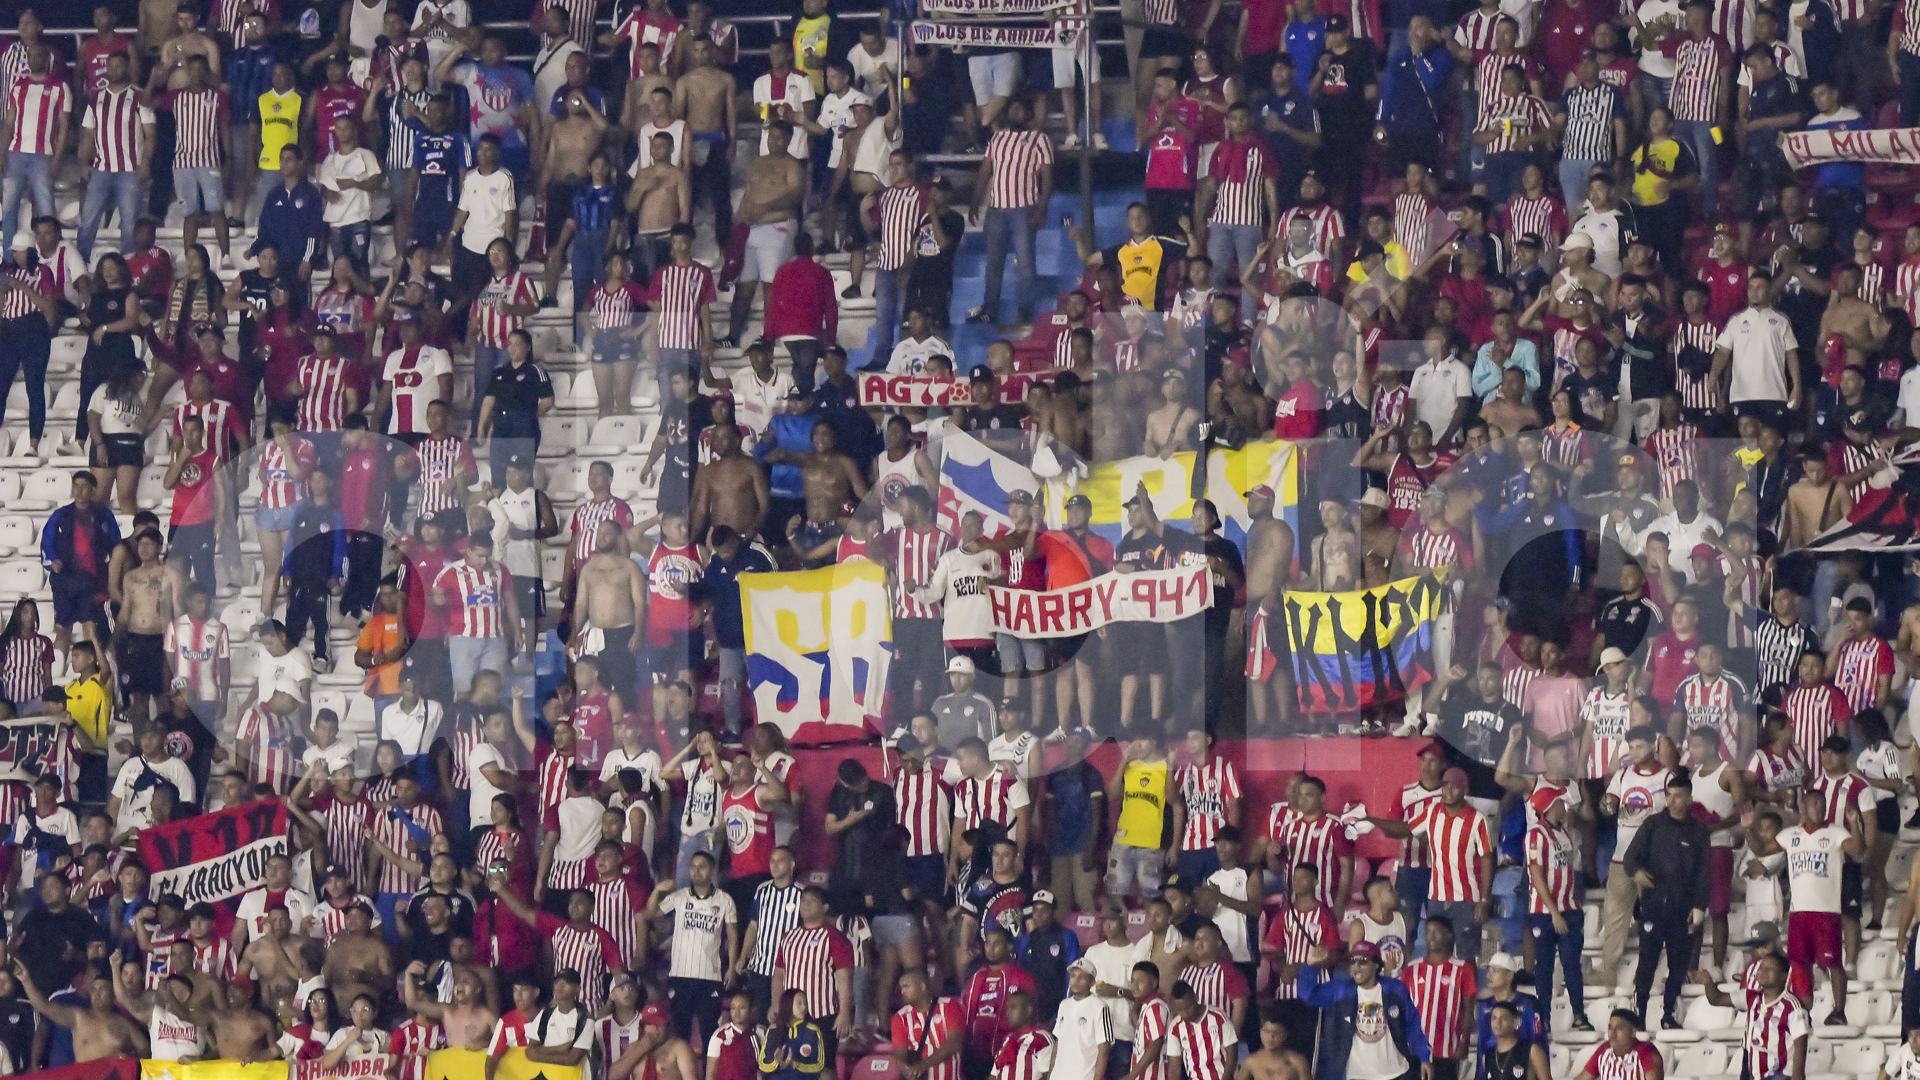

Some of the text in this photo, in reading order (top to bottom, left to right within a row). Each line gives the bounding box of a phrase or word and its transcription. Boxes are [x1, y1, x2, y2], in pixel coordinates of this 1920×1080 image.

[1791, 836, 1801, 847] 10
[684, 911, 719, 924] CERVEZA
[684, 919, 716, 933] AGUILA
